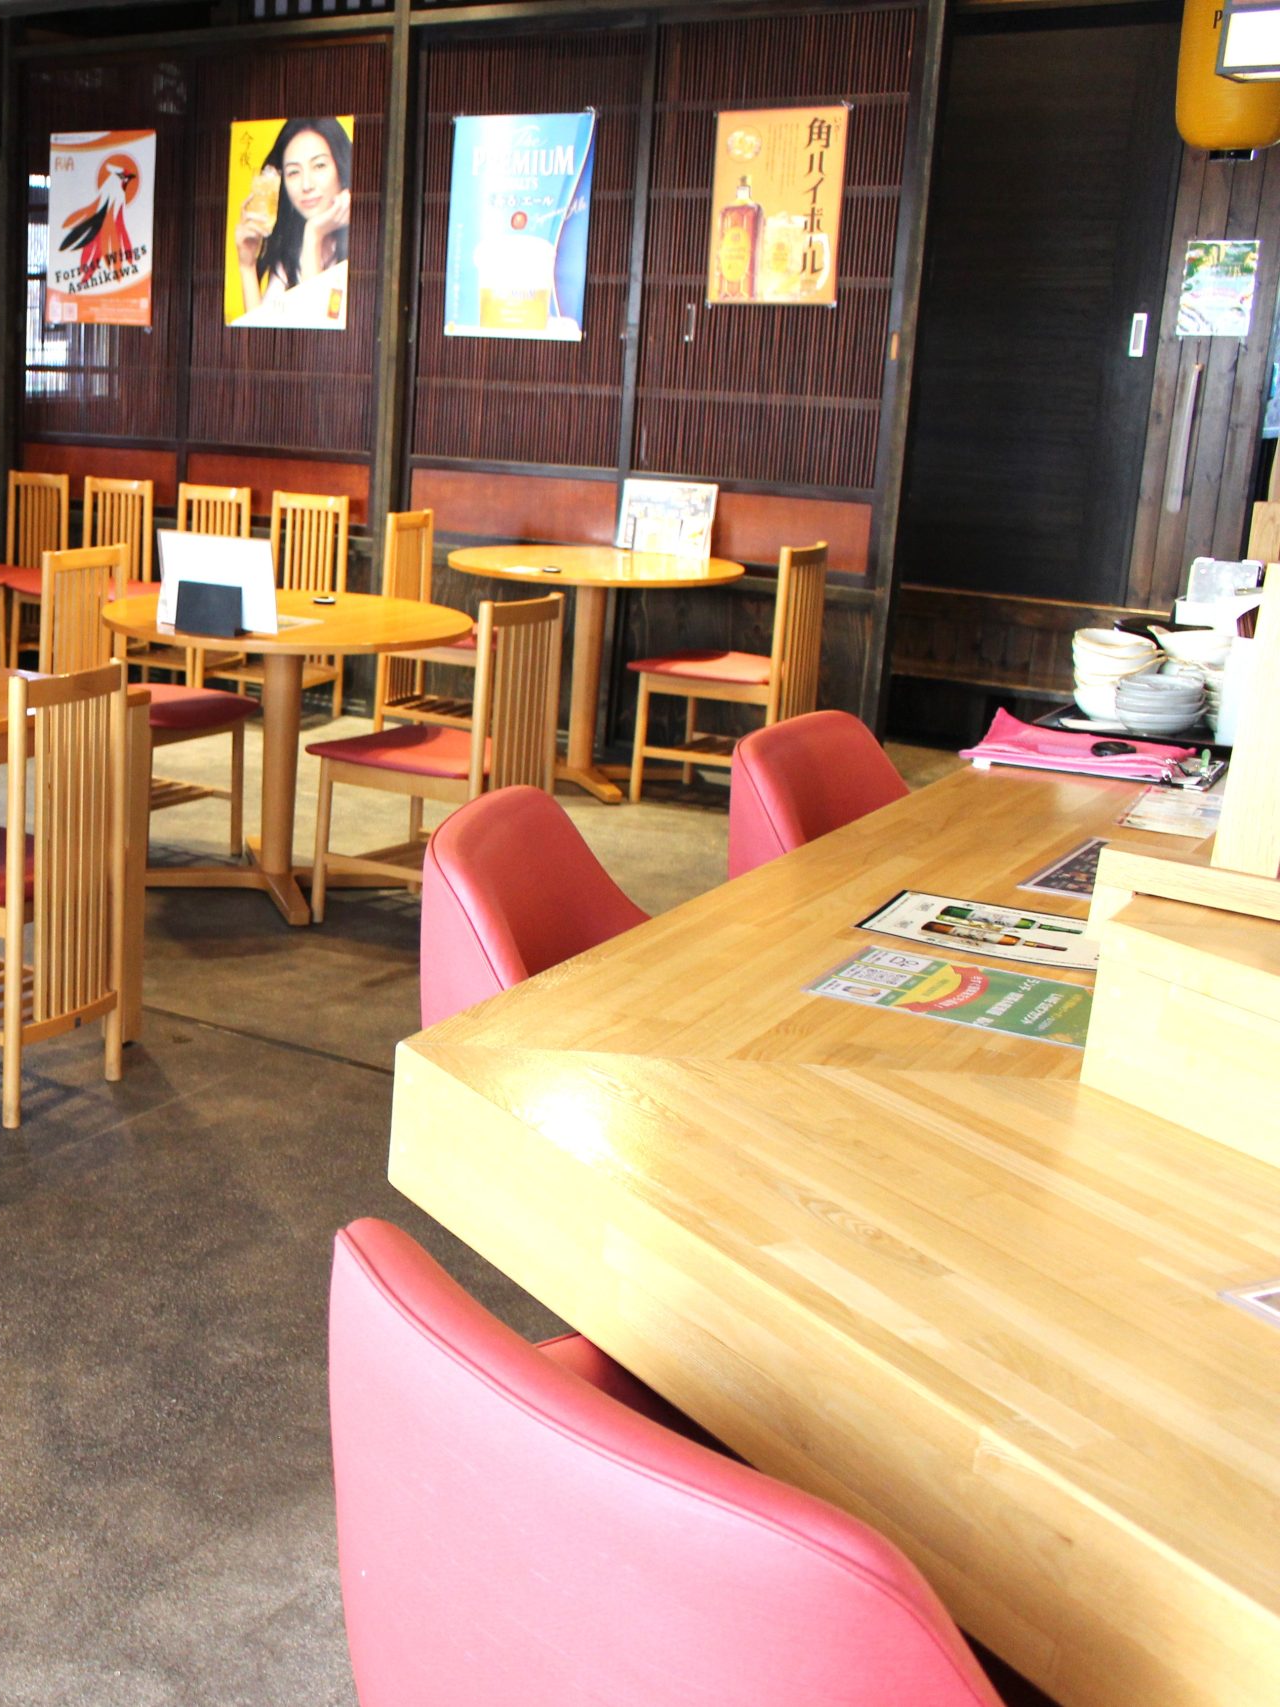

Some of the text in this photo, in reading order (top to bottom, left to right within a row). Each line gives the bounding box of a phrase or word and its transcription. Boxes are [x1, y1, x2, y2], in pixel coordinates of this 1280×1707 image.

[471, 145, 575, 176] PMIUM
[800, 117, 833, 276] 角ハイボール
[105, 244, 147, 266] Wings
[68, 264, 139, 294] Asahikawa
